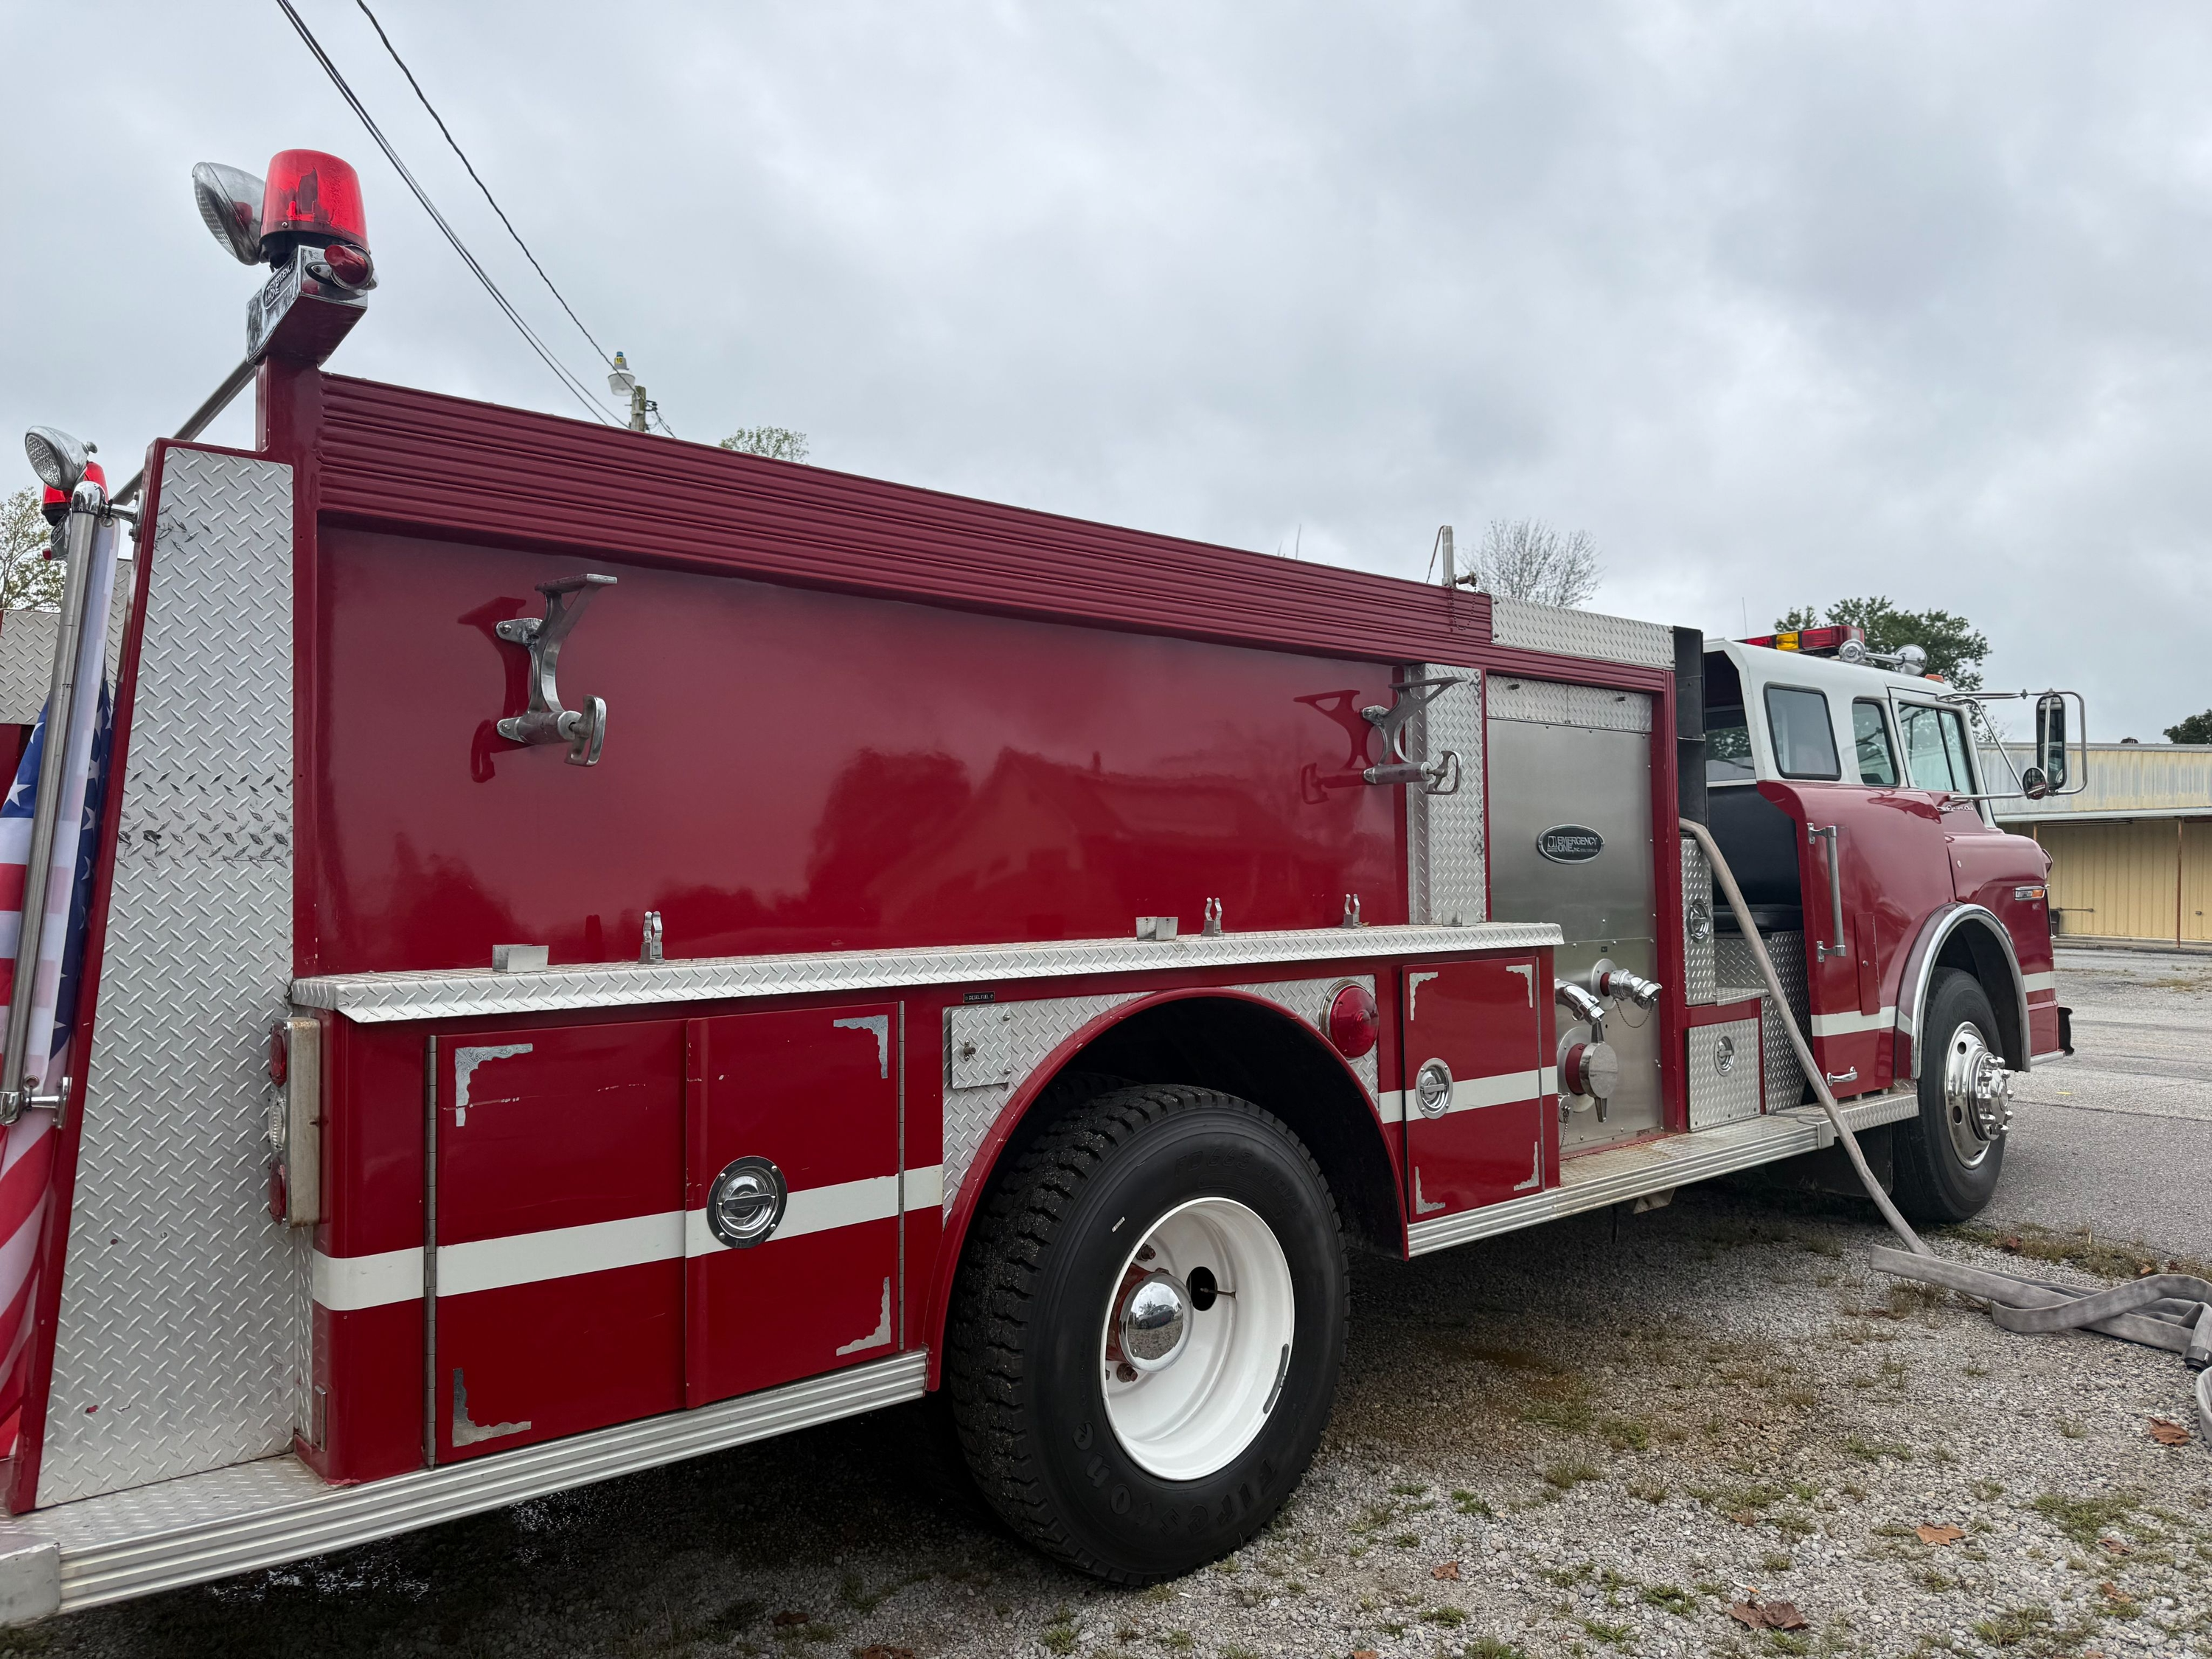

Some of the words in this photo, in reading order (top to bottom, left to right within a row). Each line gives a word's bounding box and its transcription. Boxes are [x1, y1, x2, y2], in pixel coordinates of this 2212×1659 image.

[1557, 836, 1598, 846] EMERGENCY
[1257, 1166, 1302, 1216] RADIAL
[1071, 1420, 1278, 1538] Firestone
